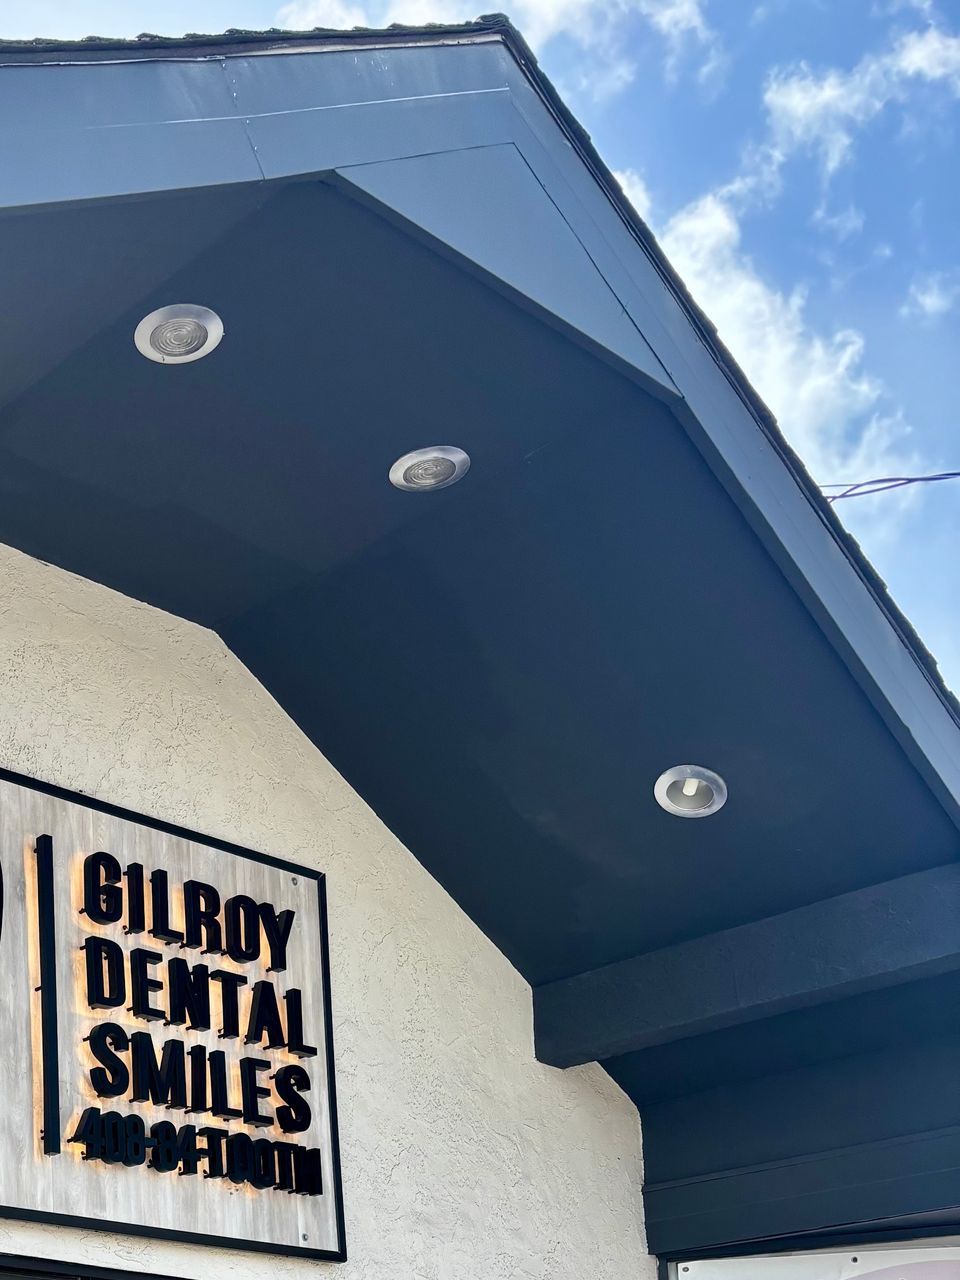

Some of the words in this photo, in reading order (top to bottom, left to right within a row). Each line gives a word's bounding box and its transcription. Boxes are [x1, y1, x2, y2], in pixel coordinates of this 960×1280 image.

[82, 851, 295, 973] GILROY
[85, 936, 317, 1058] DENTAL
[89, 1022, 312, 1134] SMILES
